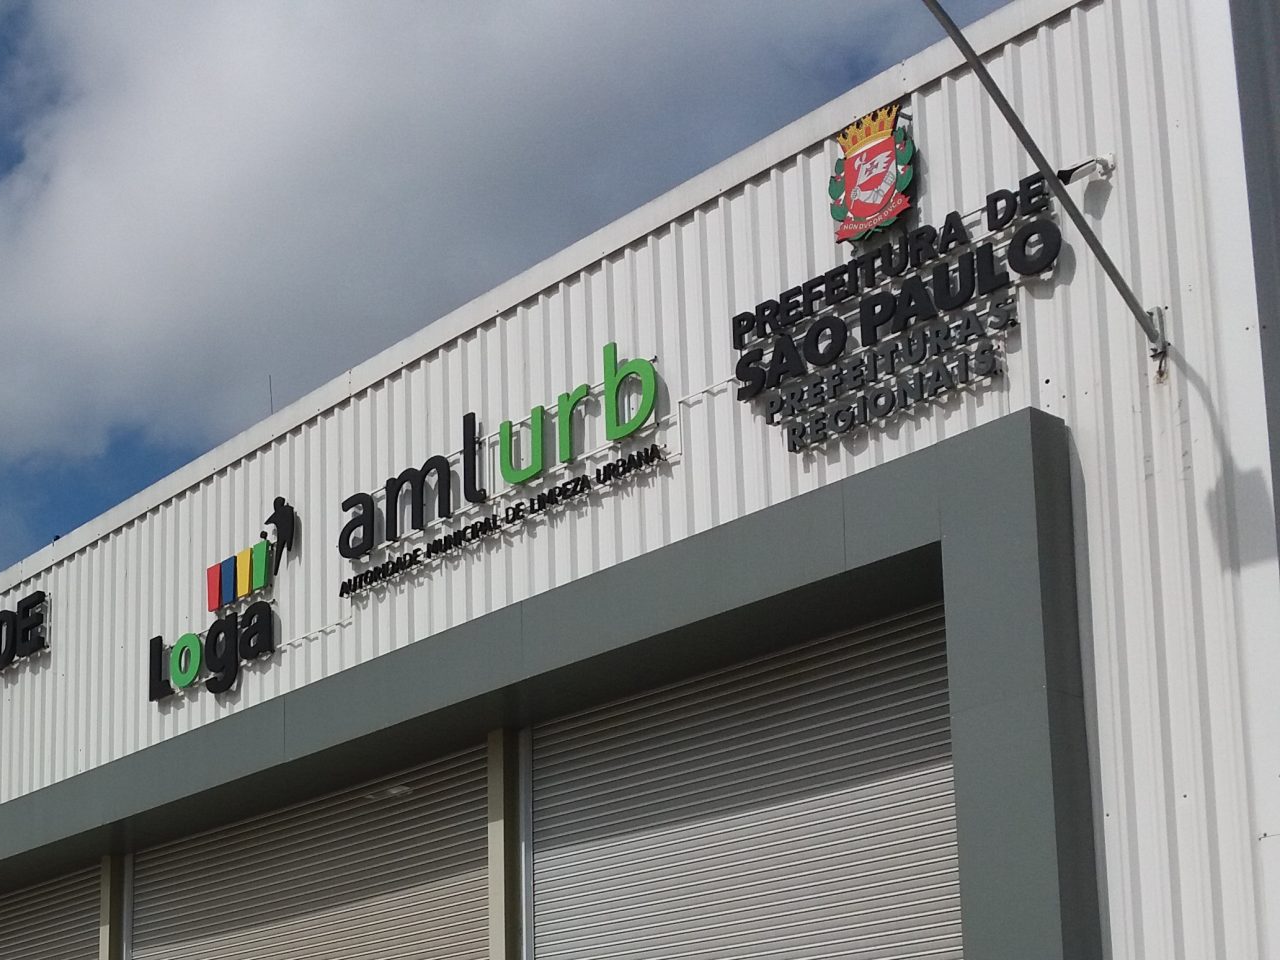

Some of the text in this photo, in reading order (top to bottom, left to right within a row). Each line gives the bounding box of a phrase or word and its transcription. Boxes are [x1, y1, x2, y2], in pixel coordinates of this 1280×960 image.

[733, 170, 1047, 350] PREFEITURA DE
[859, 219, 1062, 347] PAULO
[765, 299, 1011, 425] PREFEITURAS
[787, 340, 998, 454] REGIONAIS
[339, 443, 663, 597] AUTORIDADE MUNICIPAL DE LIMPEZA URBANA
